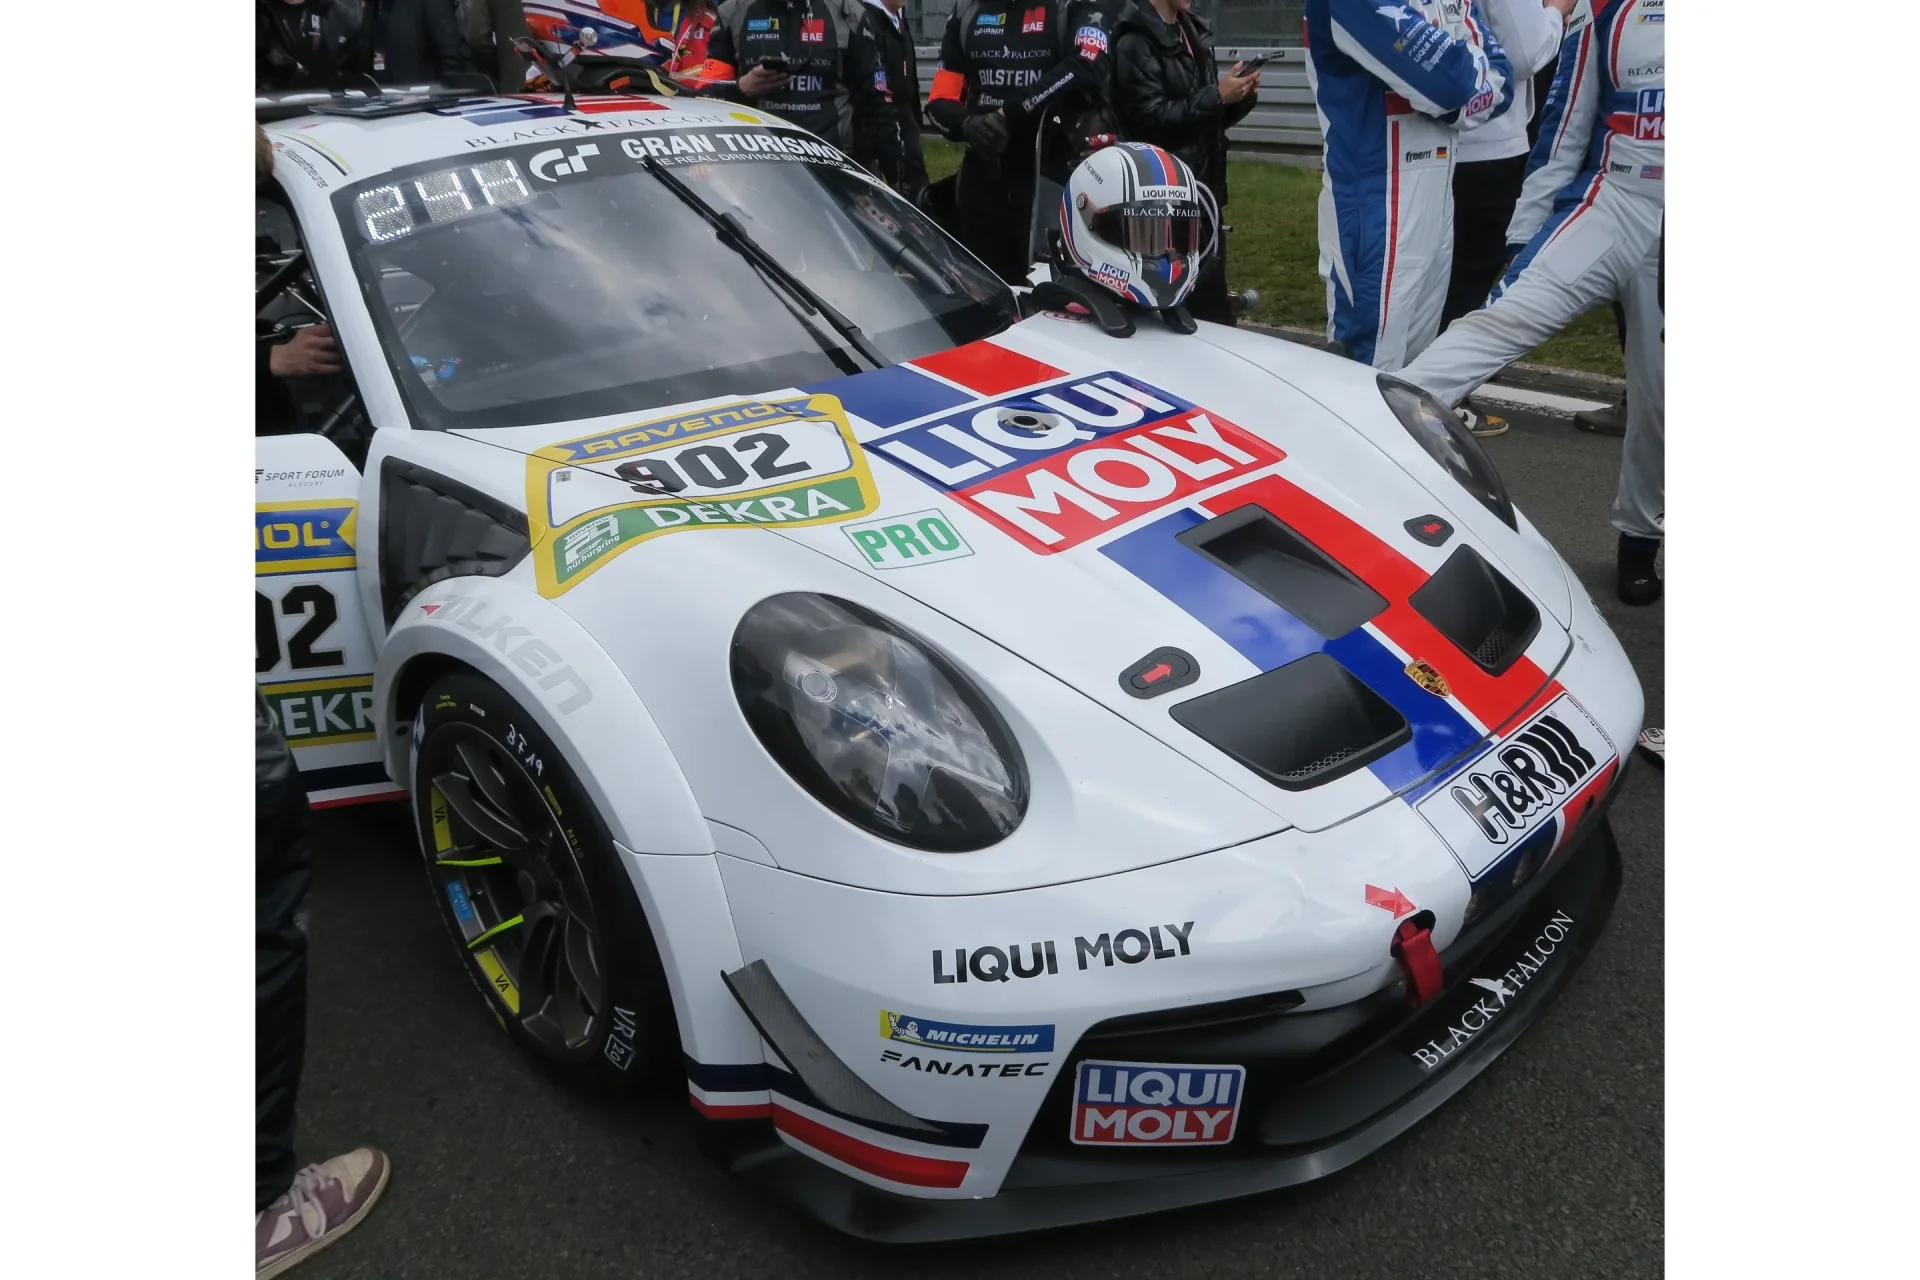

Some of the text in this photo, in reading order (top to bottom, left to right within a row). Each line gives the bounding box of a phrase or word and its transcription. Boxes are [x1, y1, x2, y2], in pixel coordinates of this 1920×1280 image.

[801, 32, 824, 42] EAE
[1022, 21, 1044, 33] EAE
[970, 49, 1051, 59] BLACK FALCON
[1077, 37, 1108, 53] MOLY
[1080, 48, 1096, 60] EAE
[978, 69, 1042, 87] BILSTEIN
[1628, 66, 1664, 77] BLAC
[1032, 72, 1075, 106] Zimmermann
[464, 115, 724, 149] BLACK FALCON
[621, 133, 844, 162] GRAN TURISMO
[638, 151, 856, 171] THE REAL DRIVING SIMULATOR
[357, 158, 530, 242] 24H
[1142, 190, 1187, 199] LIQUI MOLY
[1123, 208, 1200, 217] BLACK FALCO
[1098, 274, 1129, 292] MOLY
[1101, 263, 1131, 280] LIQUI
[582, 403, 804, 454] RAVENOL
[877, 378, 1177, 487] LIQUI
[265, 468, 345, 482] SPORT FORUM
[614, 432, 813, 495] 902
[969, 413, 1260, 546] MOLY
[643, 488, 851, 529] DEKRA
[566, 534, 620, 573] nürburgring
[852, 517, 961, 563] PRO
[1451, 745, 1565, 843] H&R
[434, 806, 446, 825] VA
[932, 920, 1196, 985] LIQUI MOLY
[494, 973, 510, 993] VA
[1412, 909, 1575, 1069] BLACK FALCON
[926, 1029, 1040, 1046] MICHELIN
[880, 1050, 1050, 1078] FANATEC
[1087, 1069, 1234, 1107] LIQUI
[1082, 1108, 1234, 1141] MOLY
